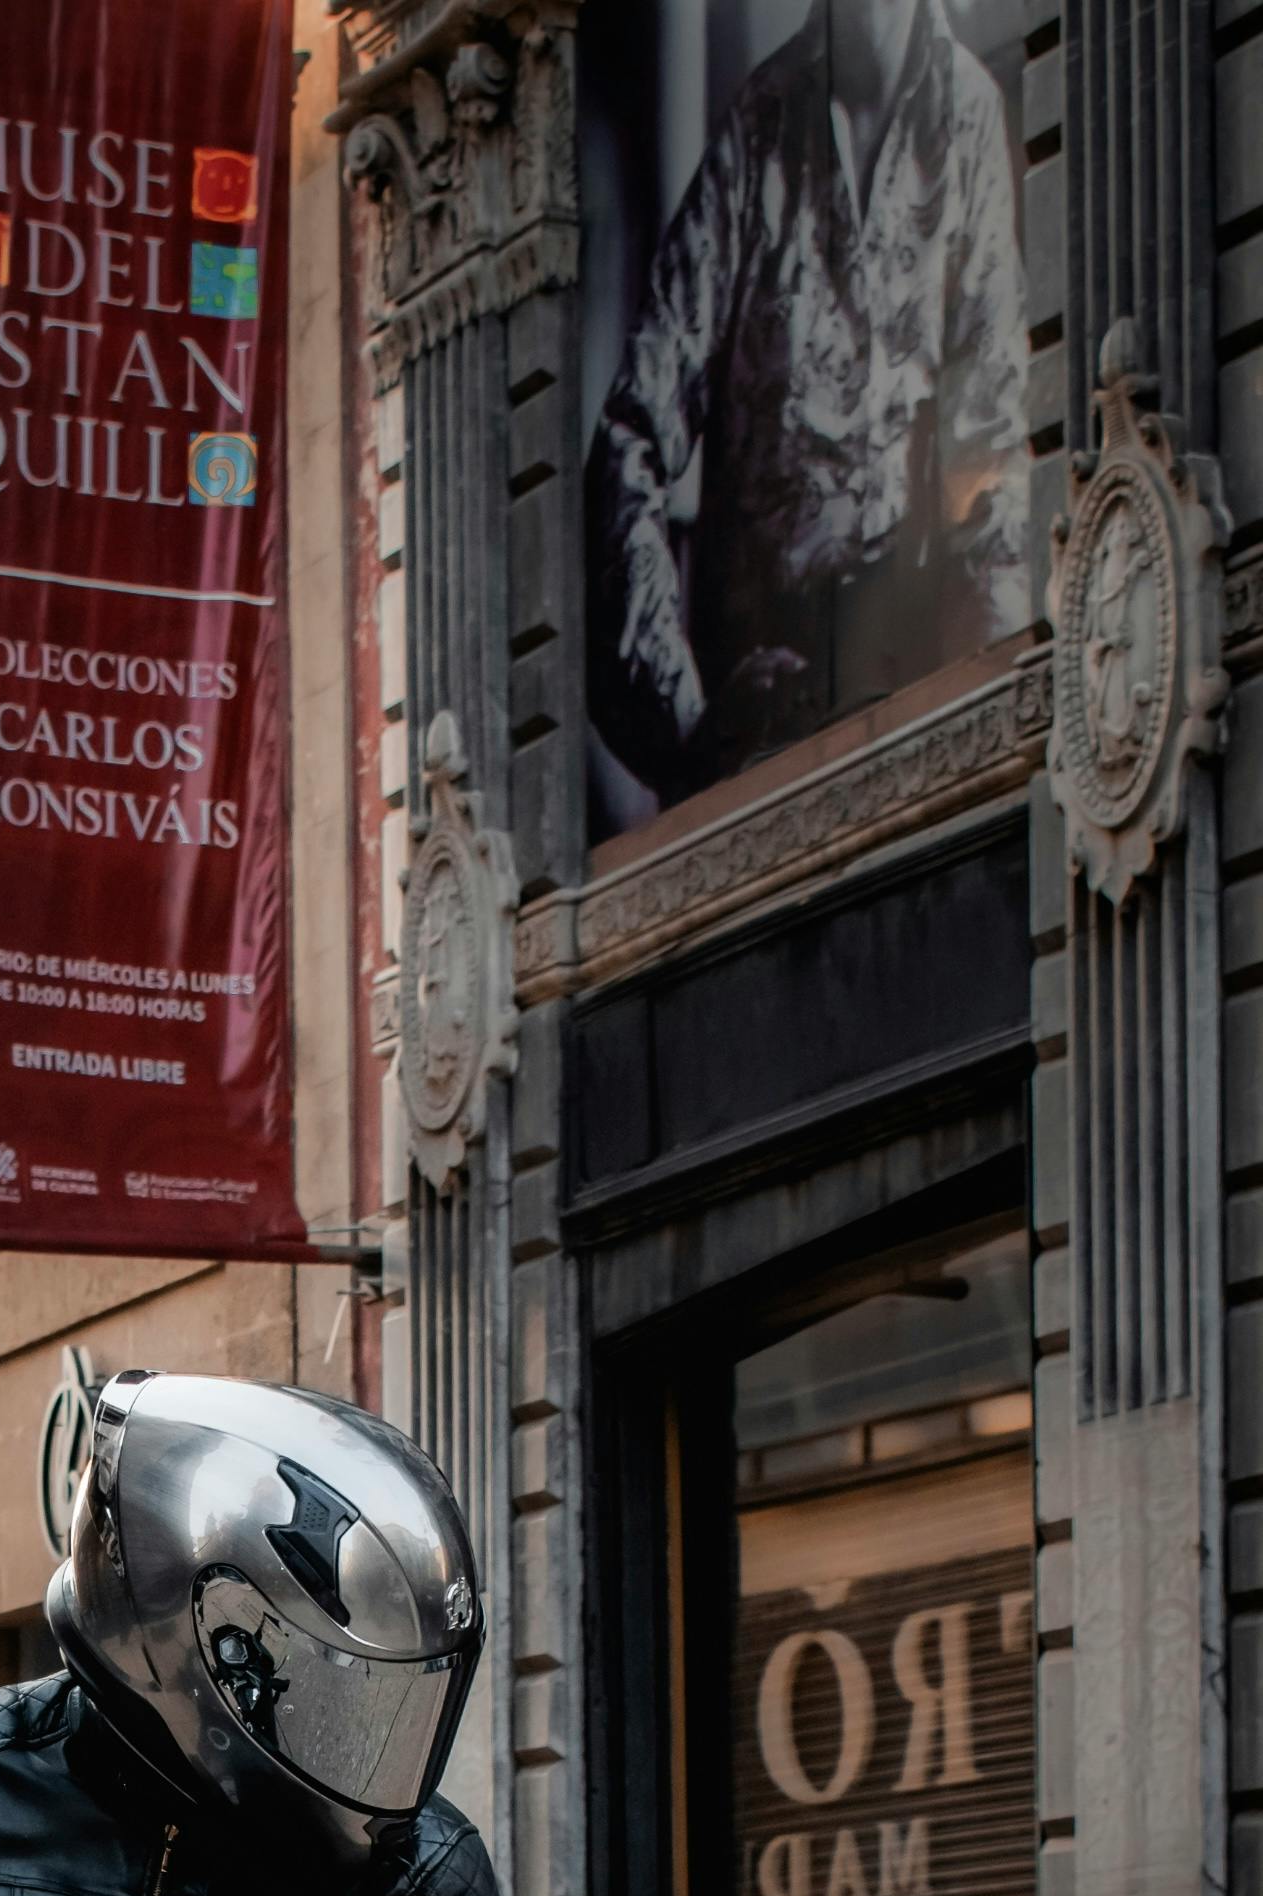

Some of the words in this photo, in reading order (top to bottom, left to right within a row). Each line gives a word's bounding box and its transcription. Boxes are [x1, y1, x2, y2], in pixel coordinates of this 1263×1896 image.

[25, 219, 182, 313] DEL
[37, 954, 62, 978] DE
[64, 955, 170, 990] MIÉRCOLES
[172, 969, 188, 991] A
[190, 971, 256, 995] LUNES
[68, 988, 83, 1010] A
[138, 996, 207, 1023] HORAS
[11, 1042, 117, 1079] ENTRADA
[120, 1056, 186, 1086] LIBRE
